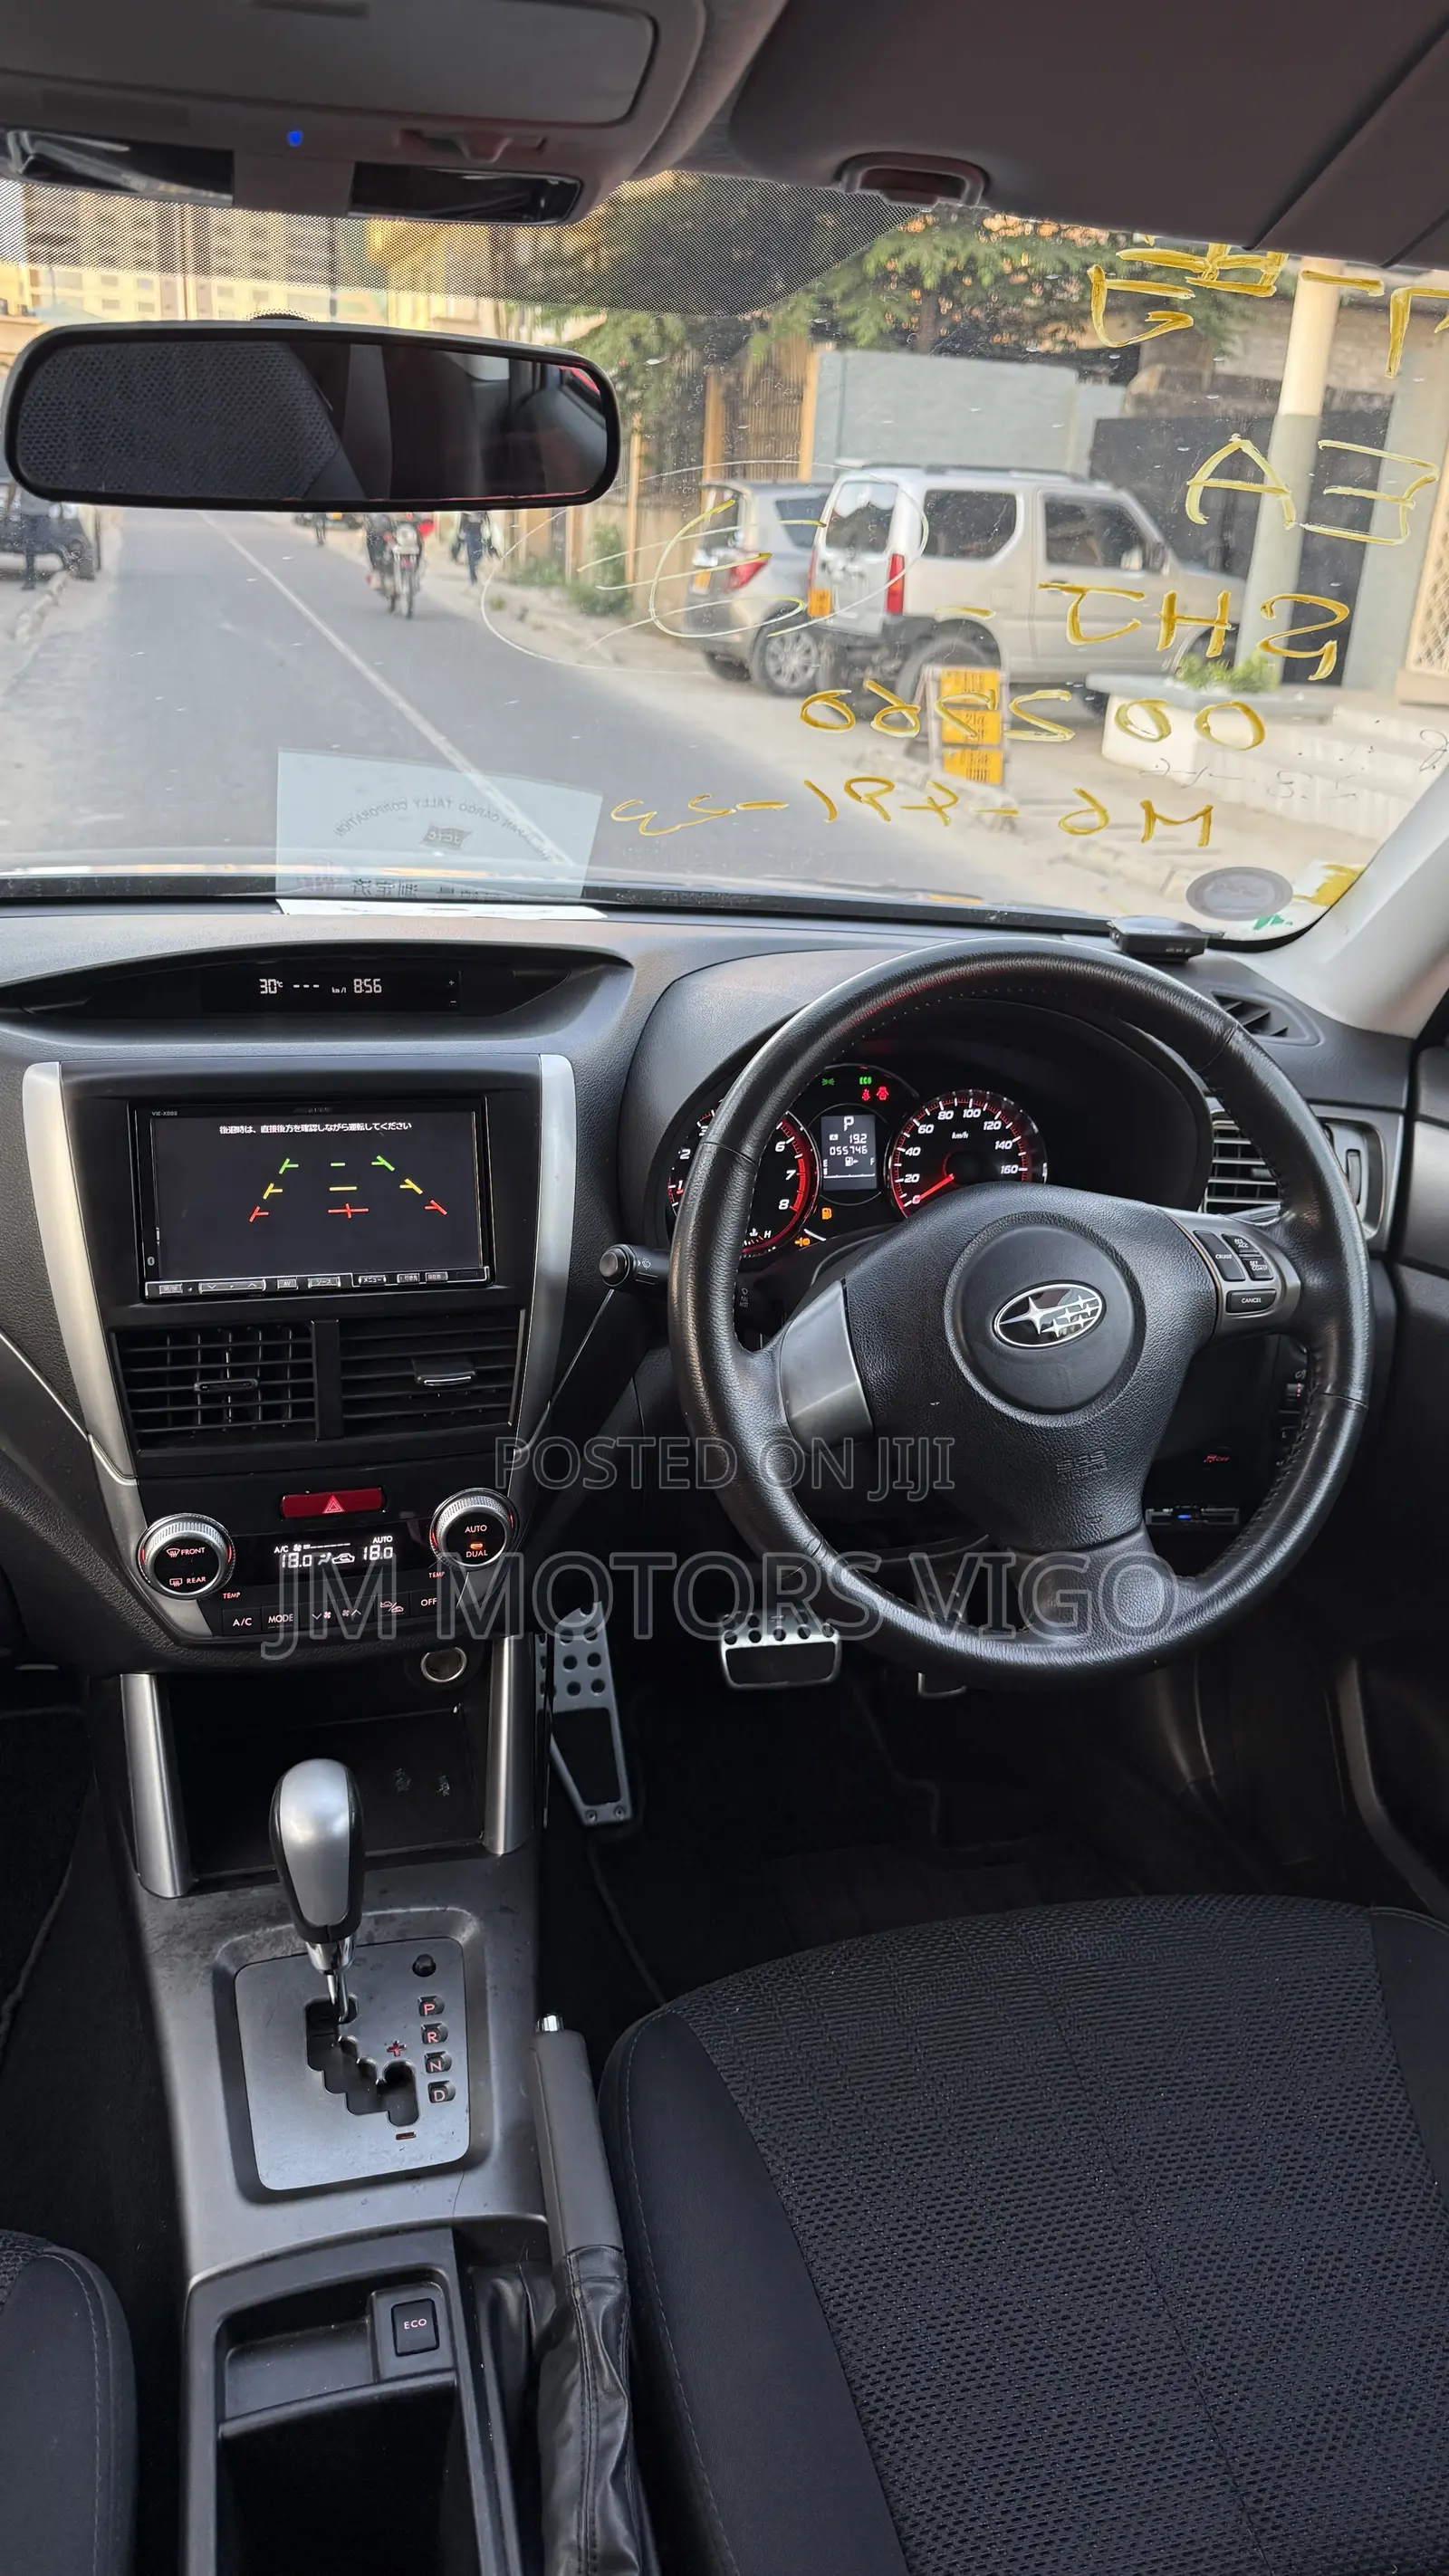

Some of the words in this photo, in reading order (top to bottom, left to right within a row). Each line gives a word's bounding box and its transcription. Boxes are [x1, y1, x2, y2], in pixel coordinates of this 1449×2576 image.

[353, 978, 382, 994] 8:56
[859, 1076, 872, 1086] ECO
[937, 1109, 955, 1121] 80
[963, 1108, 982, 1119] 100
[843, 1116, 855, 1132] P
[917, 1124, 935, 1135] 60
[984, 1120, 1003, 1131] 120
[849, 1133, 868, 1144] 19.2
[951, 1130, 969, 1140] km/h
[775, 1142, 786, 1153] 6
[829, 1145, 868, 1156] 055746
[994, 1140, 1013, 1150] 140
[679, 1148, 691, 1161] 2
[905, 1146, 922, 1157] 40
[822, 1159, 829, 1168] E
[869, 1157, 875, 1166] F
[1000, 1164, 1019, 1174] 160
[784, 1169, 796, 1181] 7
[904, 1173, 920, 1183] 20
[677, 1180, 684, 1191] 1
[777, 1198, 790, 1211] 8
[763, 1230, 772, 1239] H
[465, 1524, 487, 1534] AUTO
[372, 1535, 393, 1544] AUTO
[180, 1547, 206, 1556] FRONT
[273, 1545, 289, 1554] A/C
[362, 1544, 394, 1561] 18.0
[465, 1549, 488, 1558] DUAL
[280, 1552, 312, 1569] 18.0
[186, 1575, 206, 1585] REAR
[428, 1571, 446, 1579] TEMP
[222, 1591, 241, 1600] TEMP
[420, 1597, 437, 1607] OFF
[232, 1616, 253, 1628] A/C
[267, 1614, 294, 1624] MODE
[424, 2004, 435, 2016] P
[427, 2032, 438, 2044] R
[429, 2061, 442, 2073] N
[434, 2091, 446, 2102] D
[404, 2318, 427, 2330] ECO
